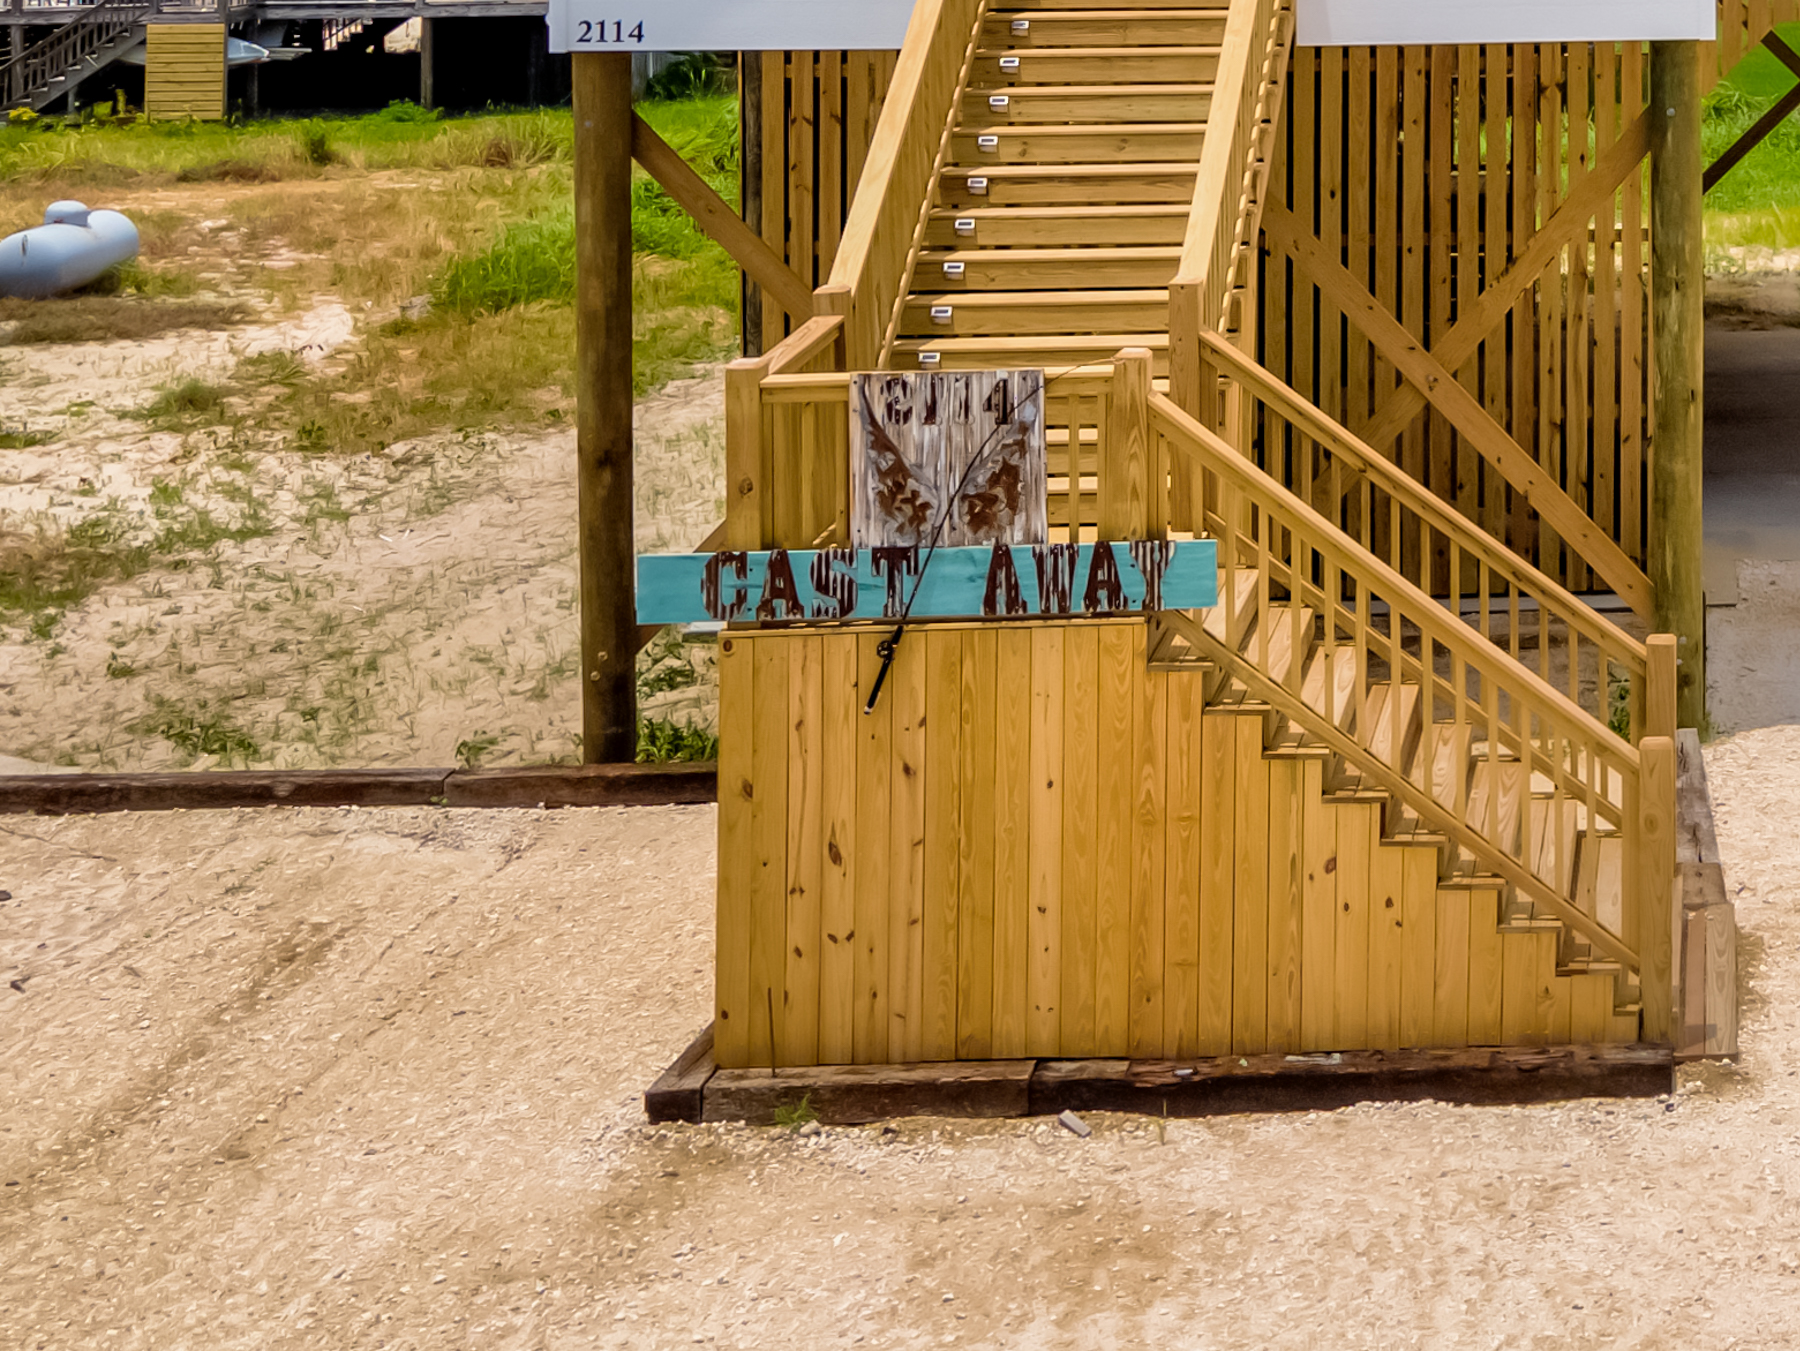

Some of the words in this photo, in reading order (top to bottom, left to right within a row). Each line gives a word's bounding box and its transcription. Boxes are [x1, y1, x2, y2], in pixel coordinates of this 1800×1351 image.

[576, 19, 645, 43] 2114
[701, 546, 920, 620] CAST
[980, 539, 1176, 616] AWAY
